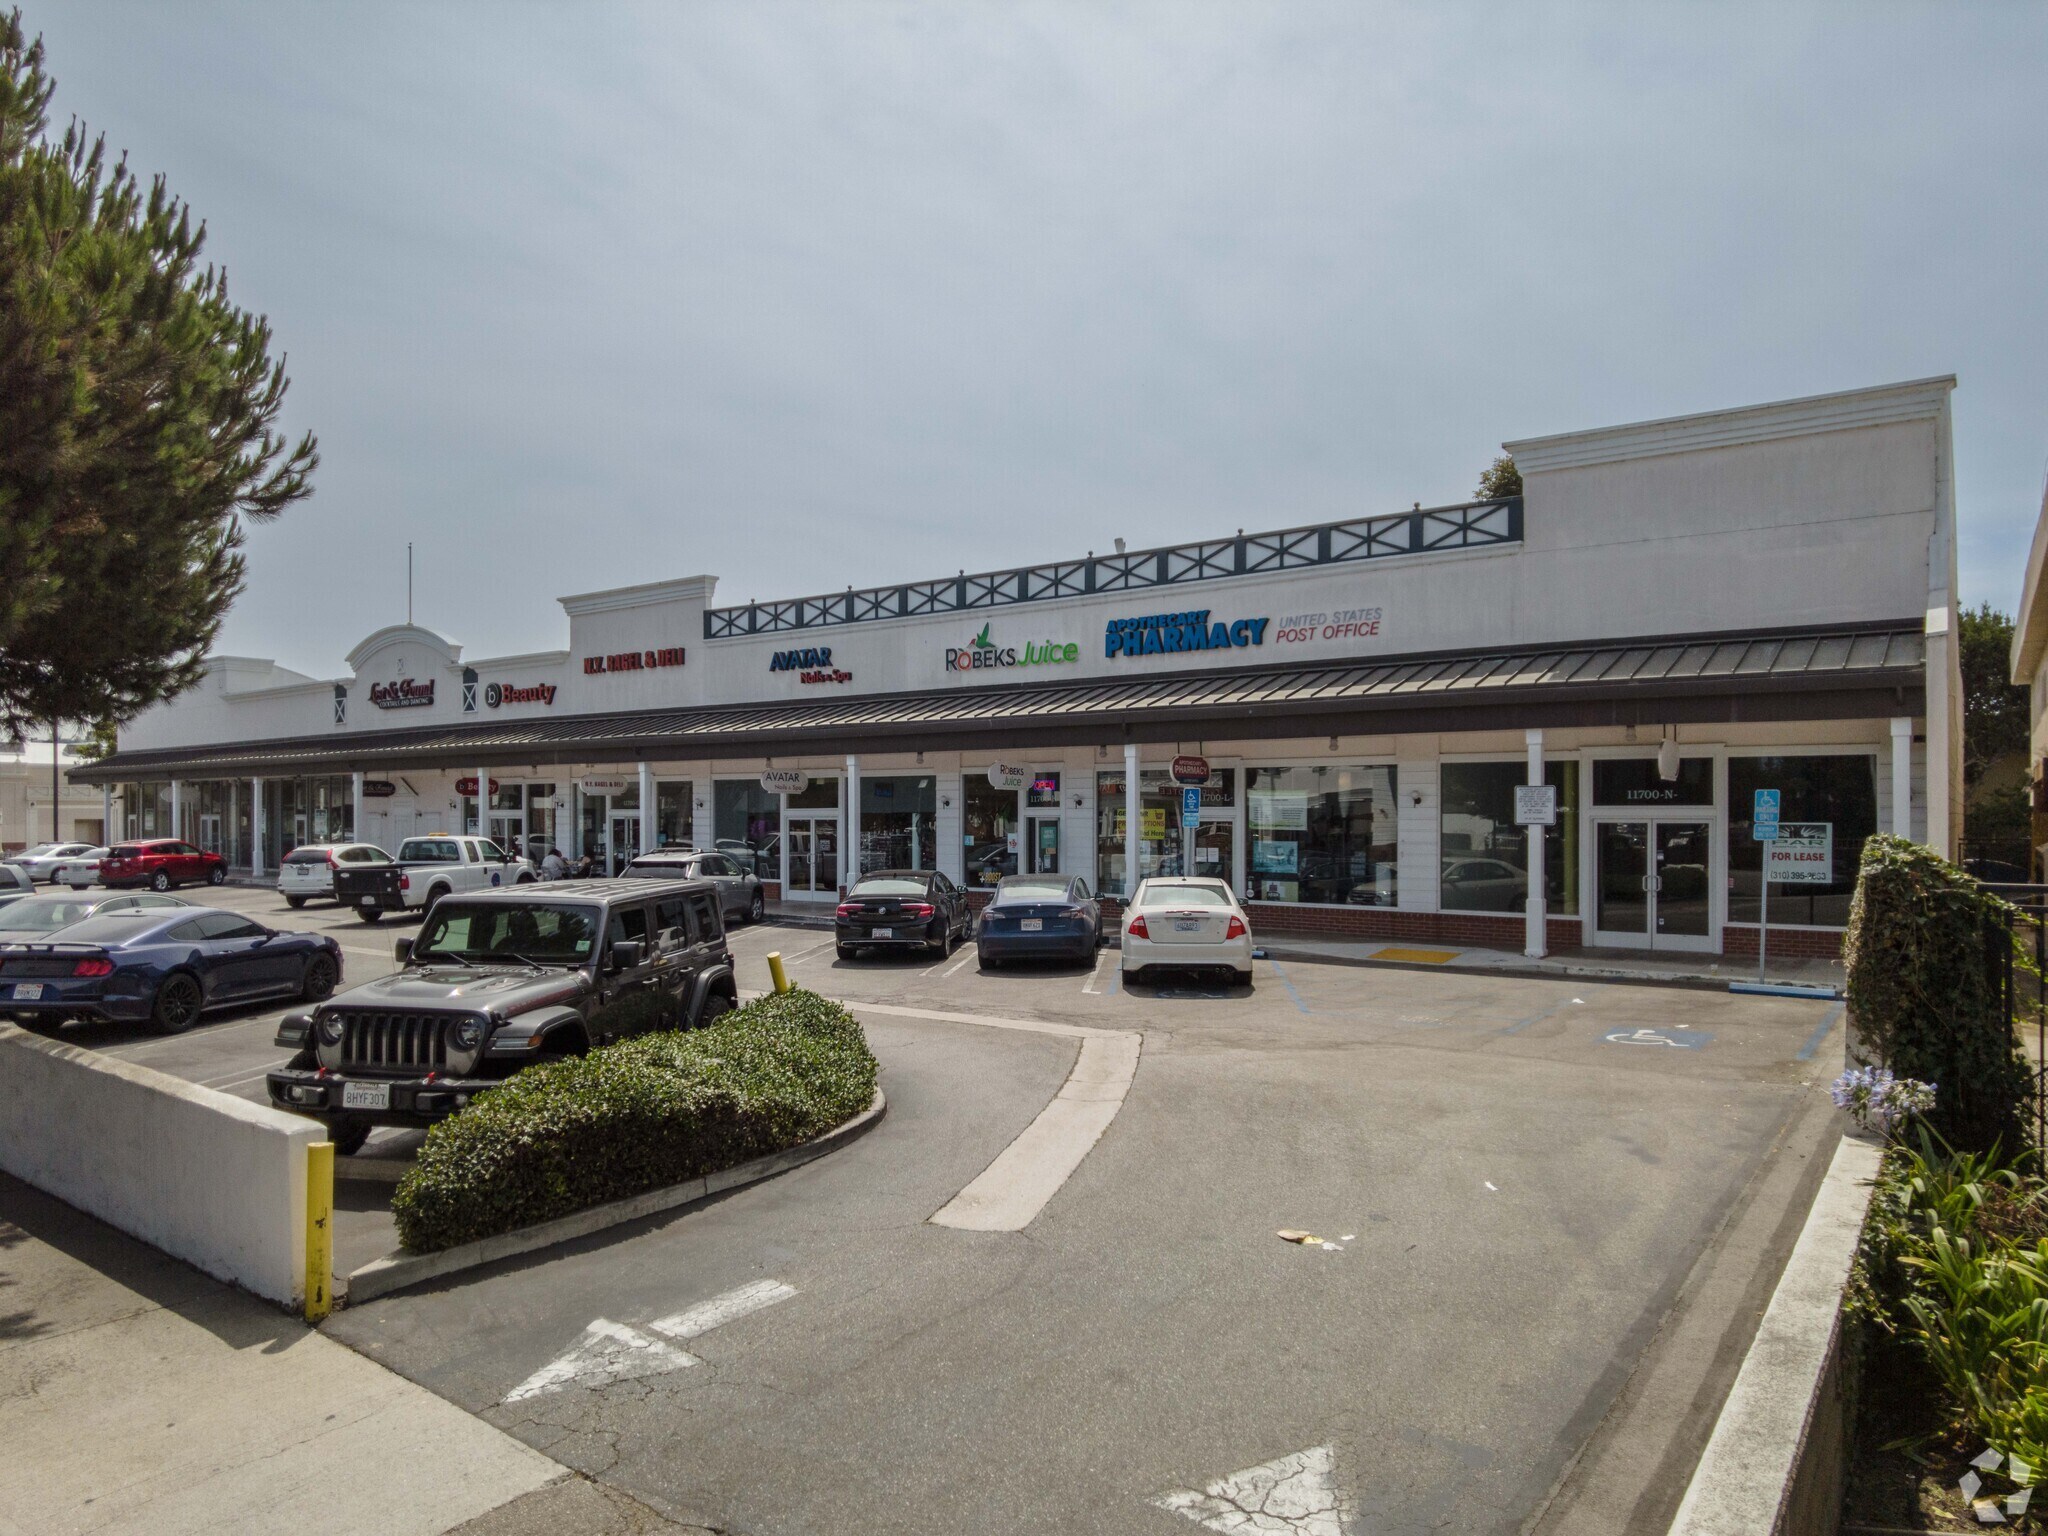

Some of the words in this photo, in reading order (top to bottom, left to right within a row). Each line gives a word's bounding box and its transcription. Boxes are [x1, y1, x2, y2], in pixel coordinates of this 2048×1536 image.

[1106, 610, 1211, 633] APOTHECARY
[1280, 613, 1327, 628] UNITED
[1332, 607, 1382, 624] STATES
[1105, 618, 1270, 658] PHARMACY
[1276, 627, 1317, 643] POST
[1323, 621, 1380, 639] OFFICE
[584, 656, 606, 674] N.Y.
[607, 652, 642, 672] BAGEL
[645, 651, 657, 668] &
[658, 648, 685, 666] DELI
[769, 647, 833, 671] AVATAR
[946, 648, 1015, 671] ROBEKS
[1017, 639, 1078, 666] Juice
[801, 670, 823, 684] Nails
[832, 669, 852, 684] Spa
[399, 679, 435, 697] Found
[501, 683, 557, 704] Beauty
[766, 772, 800, 782] AVATAR
[1000, 764, 1025, 776] ROBEKS
[1174, 765, 1208, 775] PHARMACY
[1003, 776, 1022, 787] Juice
[1771, 852, 1791, 861] FOR
[1794, 852, 1825, 861] LEASE
[1770, 870, 1789, 880] (310)
[346, 1092, 386, 1105] 8HYF307
